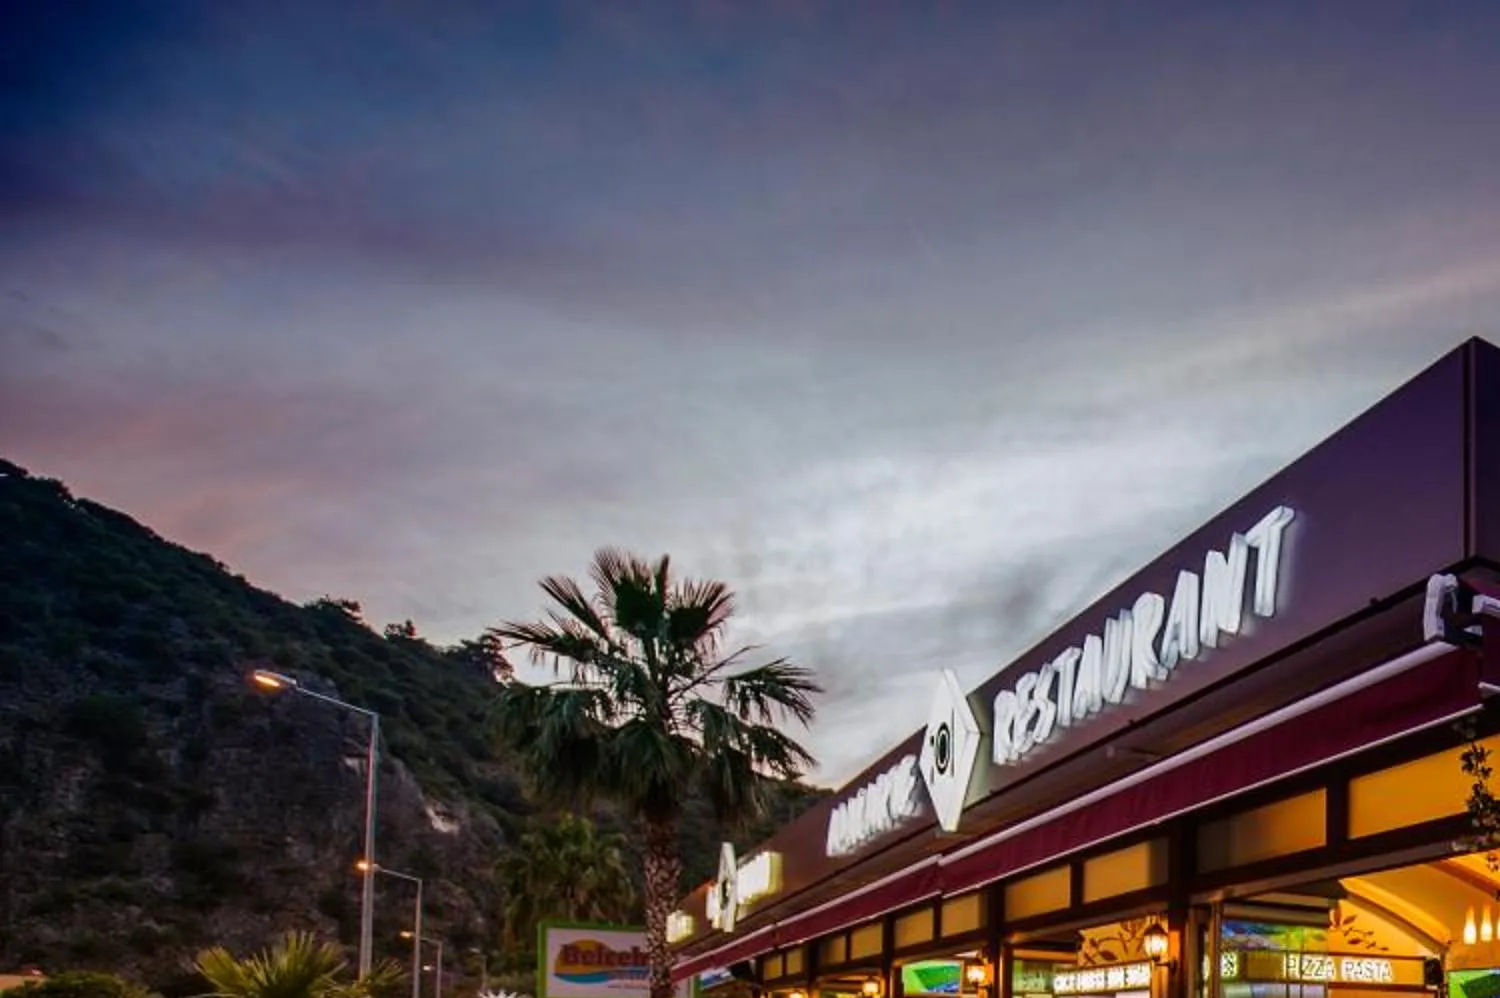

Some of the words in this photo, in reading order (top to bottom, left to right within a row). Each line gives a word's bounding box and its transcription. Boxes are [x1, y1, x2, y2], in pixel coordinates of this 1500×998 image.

[993, 505, 1295, 765] RESTAURANT
[1284, 952, 1336, 979] PIZZA
[1341, 956, 1392, 982] PASTA
